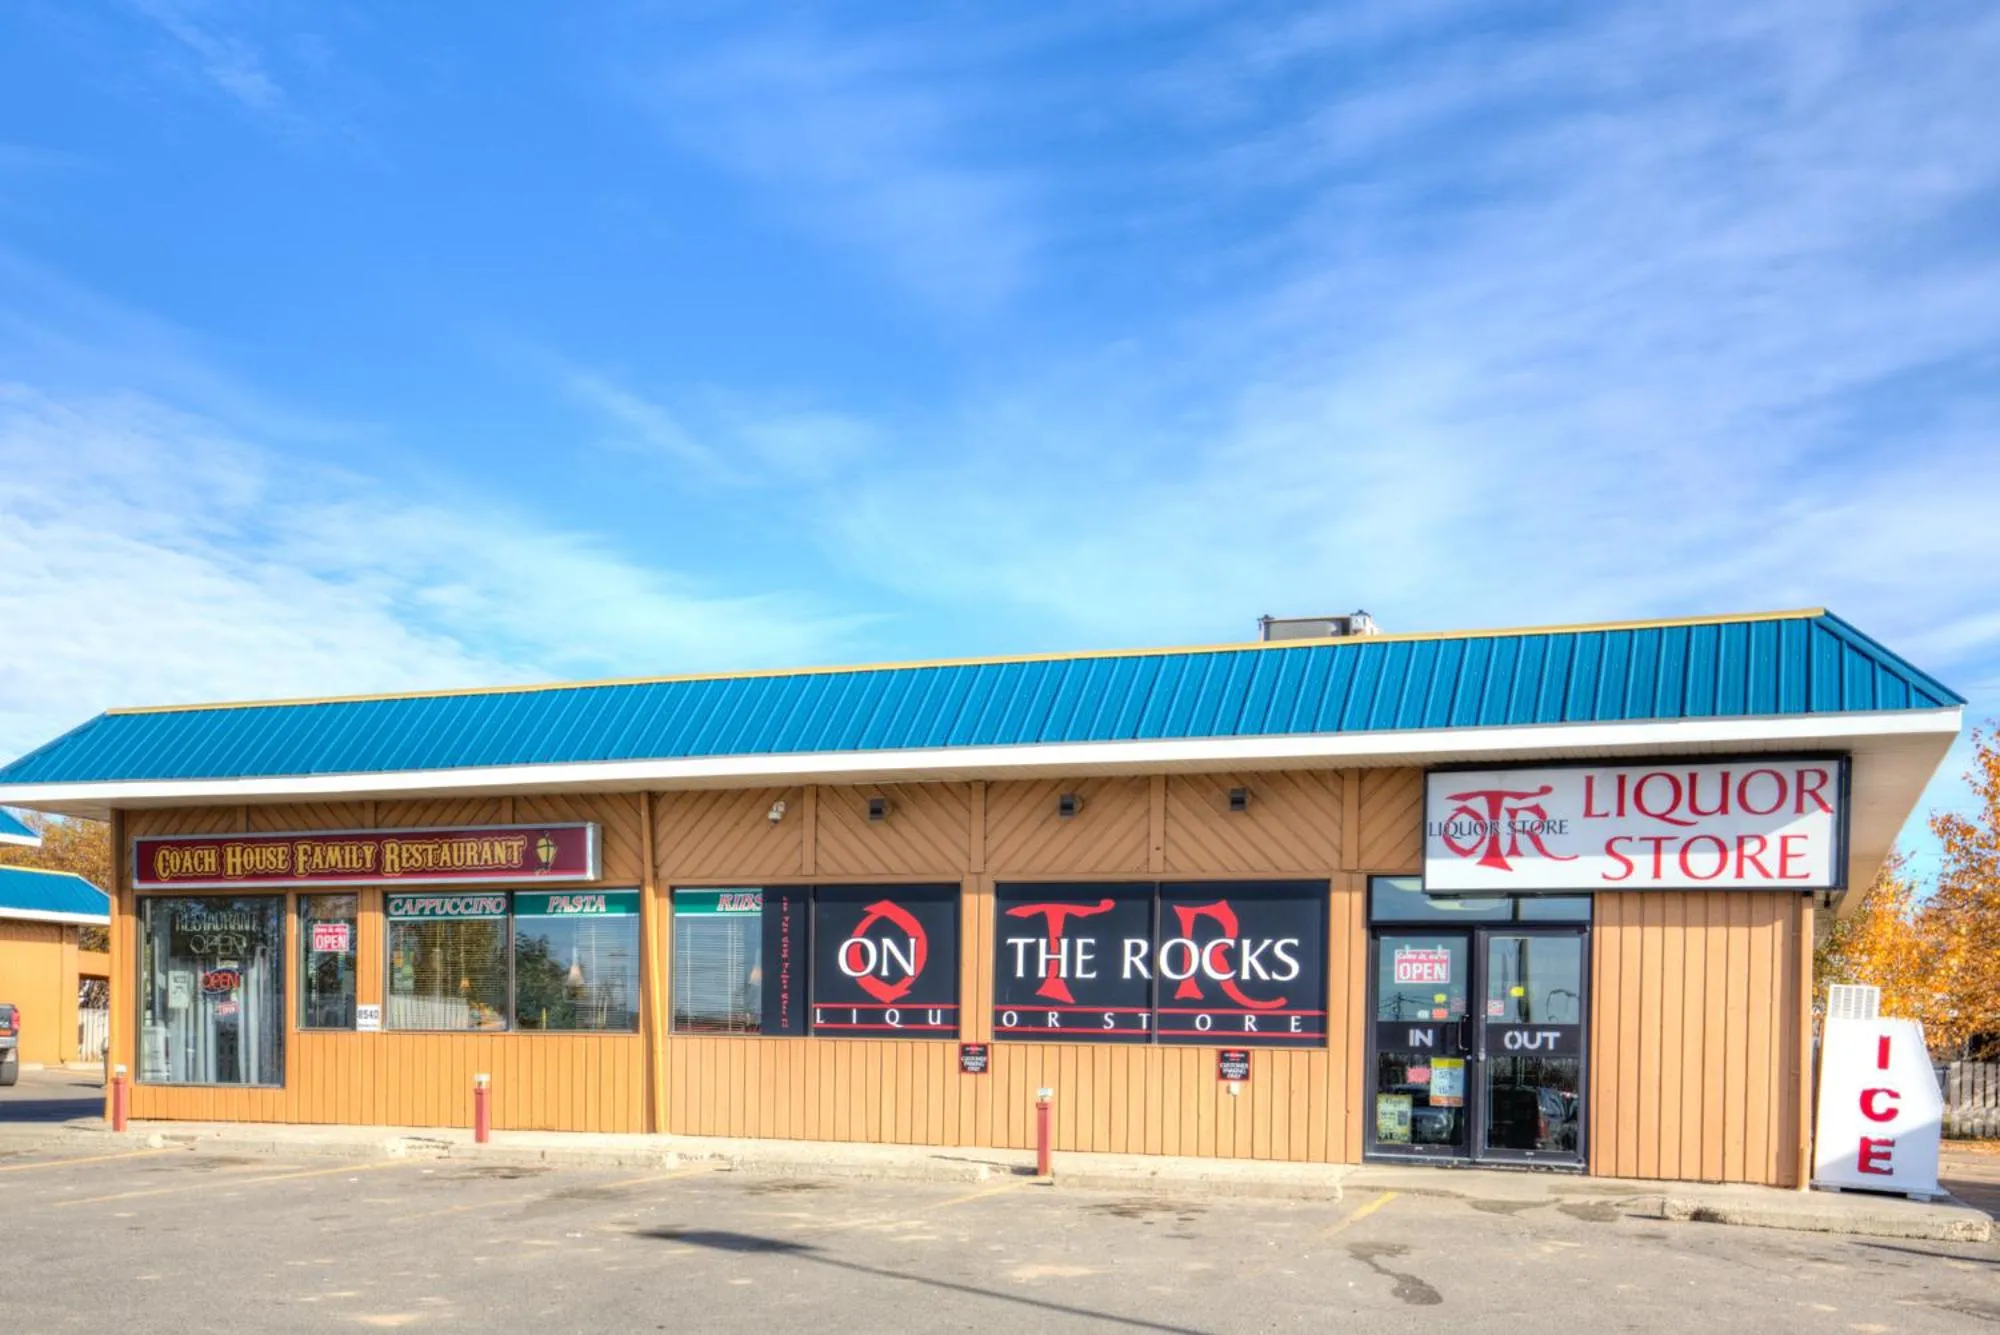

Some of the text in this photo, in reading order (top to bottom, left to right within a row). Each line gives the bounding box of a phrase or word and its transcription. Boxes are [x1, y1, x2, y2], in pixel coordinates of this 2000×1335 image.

[1583, 768, 1835, 827] LIQUOR
[1428, 818, 1569, 840] LIQUOR STORE
[155, 836, 527, 881] COACH HOUSE FAMILY RESTAURANT
[1602, 834, 1811, 881] STORE
[389, 897, 506, 916] CAPPUCCINO
[547, 894, 607, 914] PASTA
[190, 933, 248, 954] OPEN
[315, 934, 347, 950] OPEN
[838, 937, 1301, 981] ON THE ROCKS
[201, 971, 242, 991] OPEN
[1399, 962, 1447, 980] OPEN
[1408, 1029, 1433, 1047] IN
[1503, 1031, 1562, 1050] OUT
[1857, 1034, 1902, 1176] ICE
